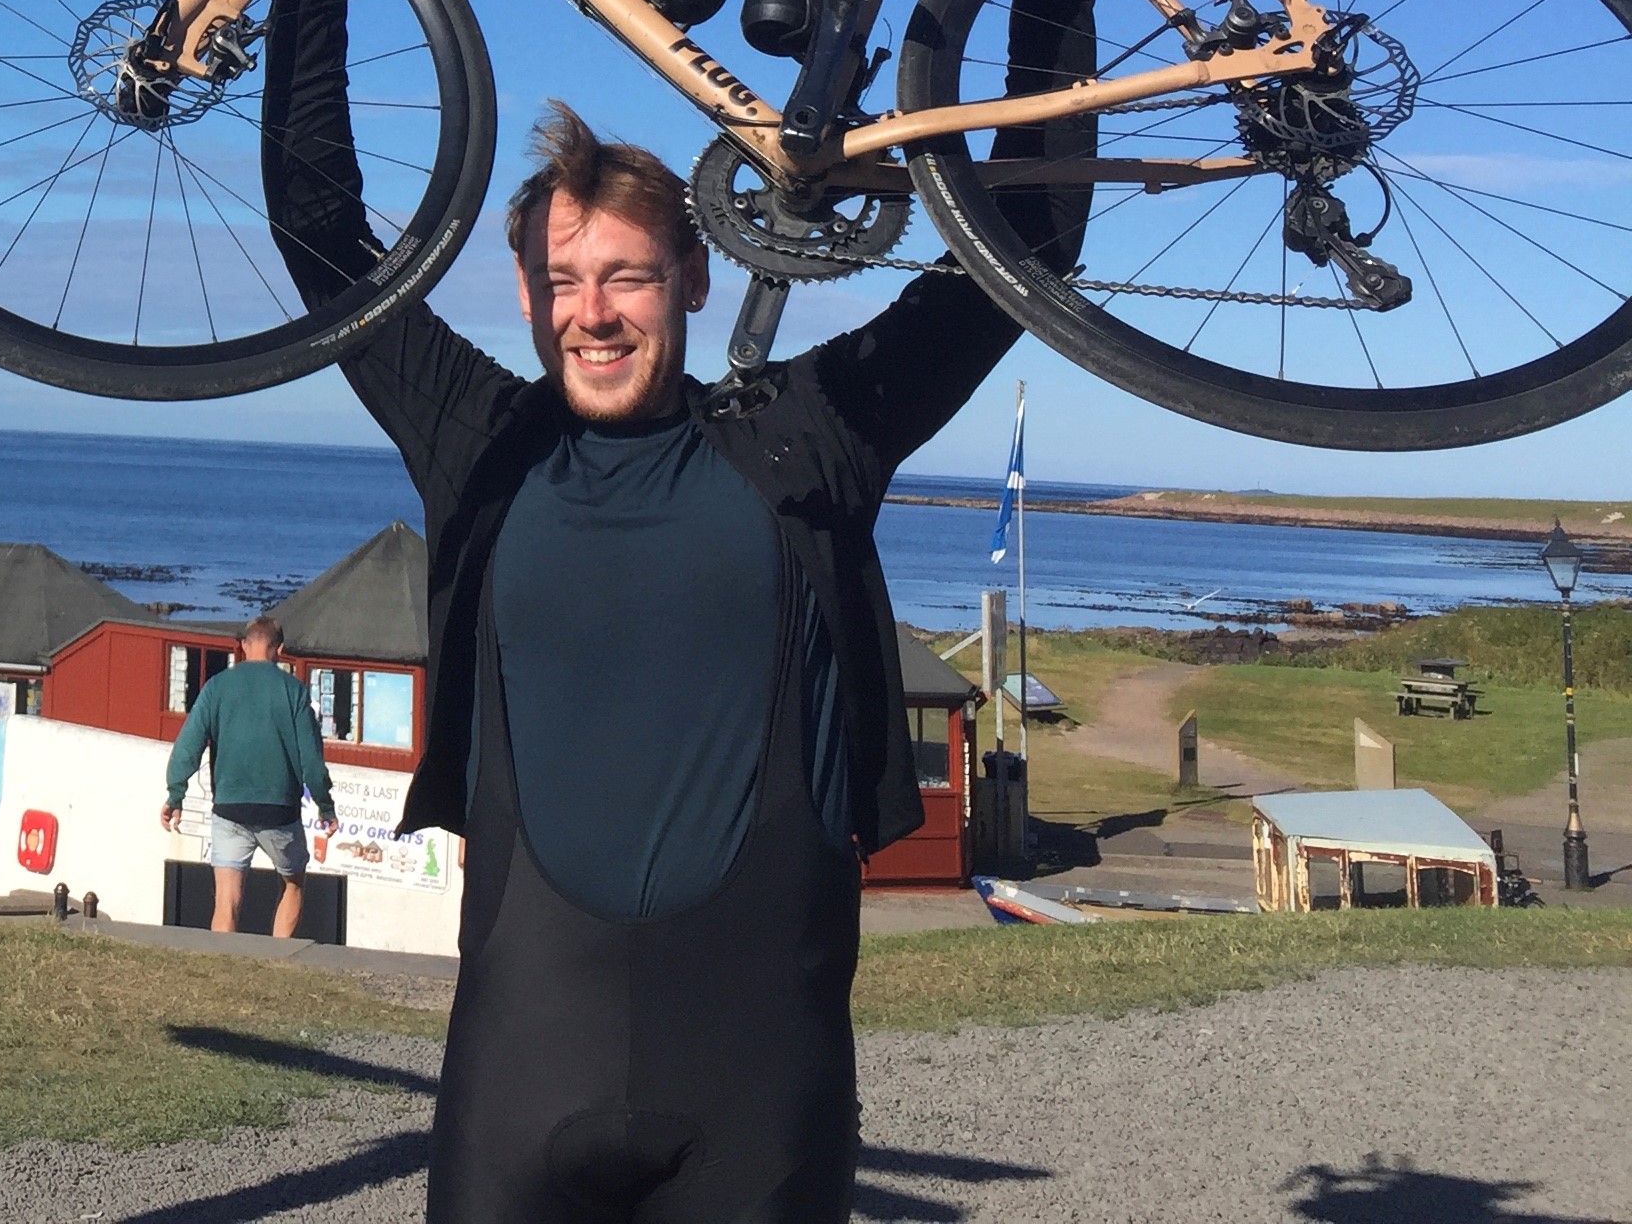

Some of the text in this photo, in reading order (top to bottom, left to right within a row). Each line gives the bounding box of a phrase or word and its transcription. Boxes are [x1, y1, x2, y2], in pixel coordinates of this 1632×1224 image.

[419, 228, 454, 273] GRAND
[973, 240, 1018, 286] GRAND
[396, 269, 424, 298] PRIX
[363, 293, 398, 323] 4000
[372, 785, 400, 801] LAST
[337, 804, 391, 823] SCOTLAND
